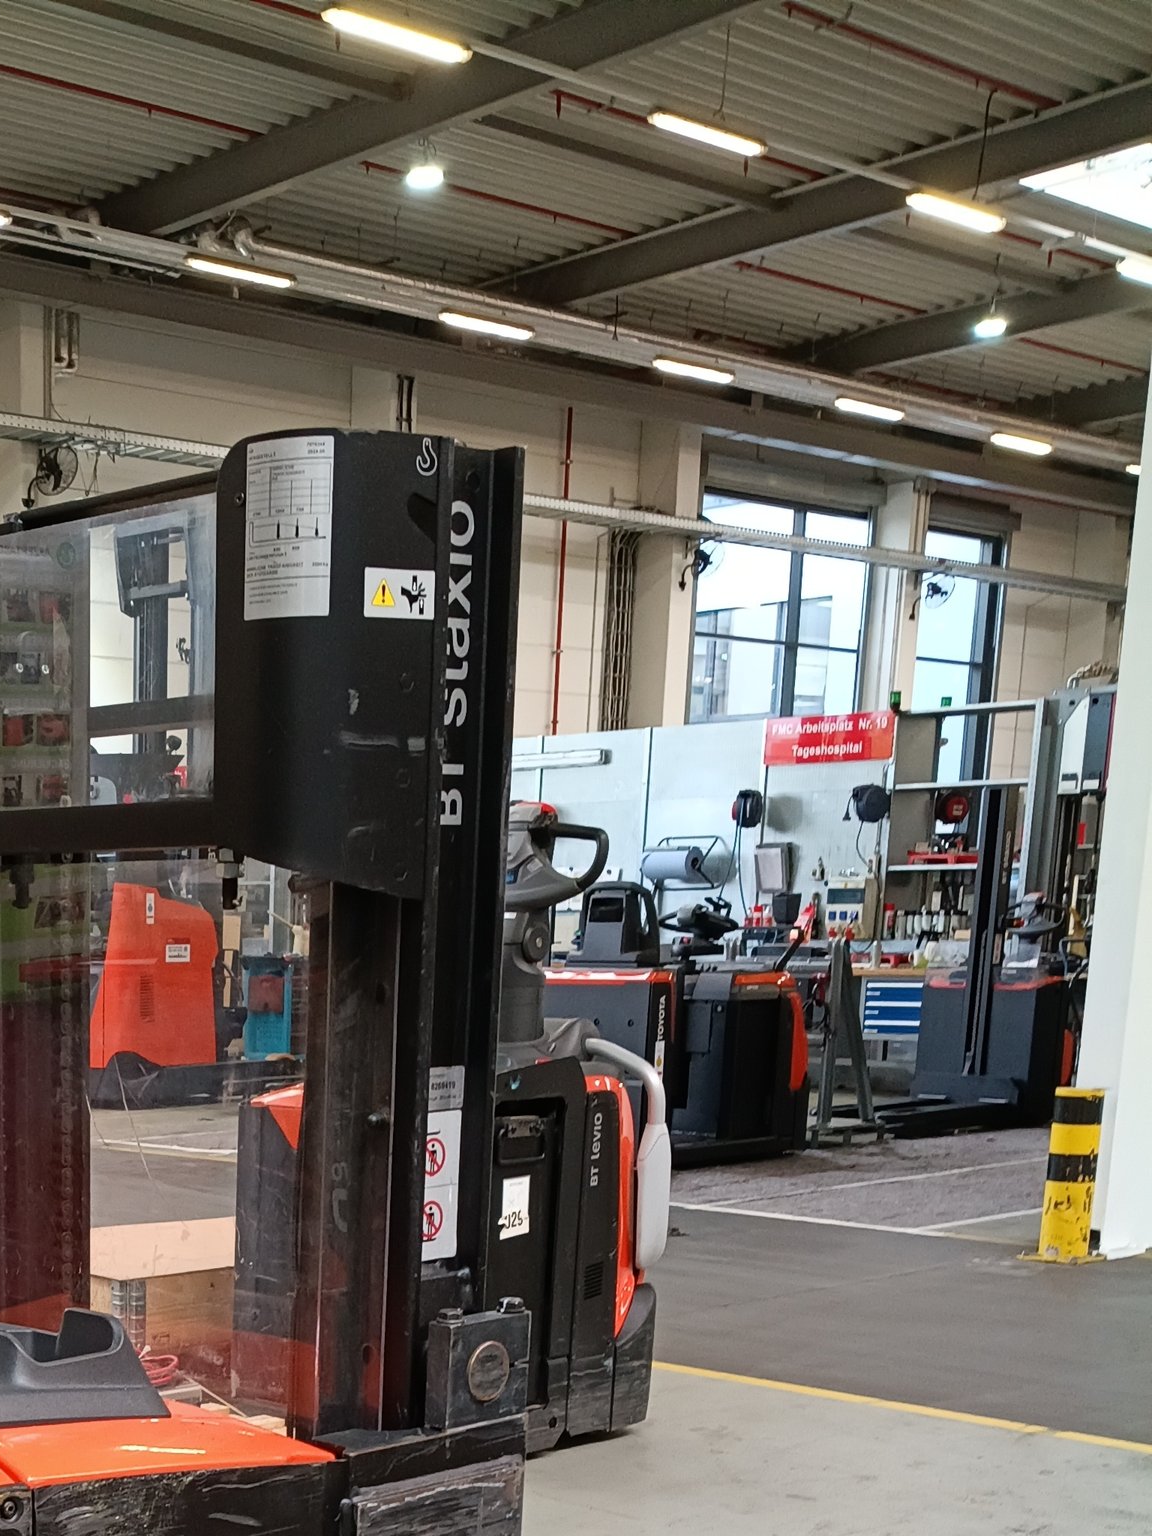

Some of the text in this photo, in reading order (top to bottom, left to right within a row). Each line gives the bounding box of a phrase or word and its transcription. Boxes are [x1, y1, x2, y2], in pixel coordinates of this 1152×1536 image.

[858, 717, 872, 731] Nr.
[791, 740, 862, 759] Tageshospital
[657, 994, 667, 1041] TOYOTA
[590, 1165, 599, 1187] BT
